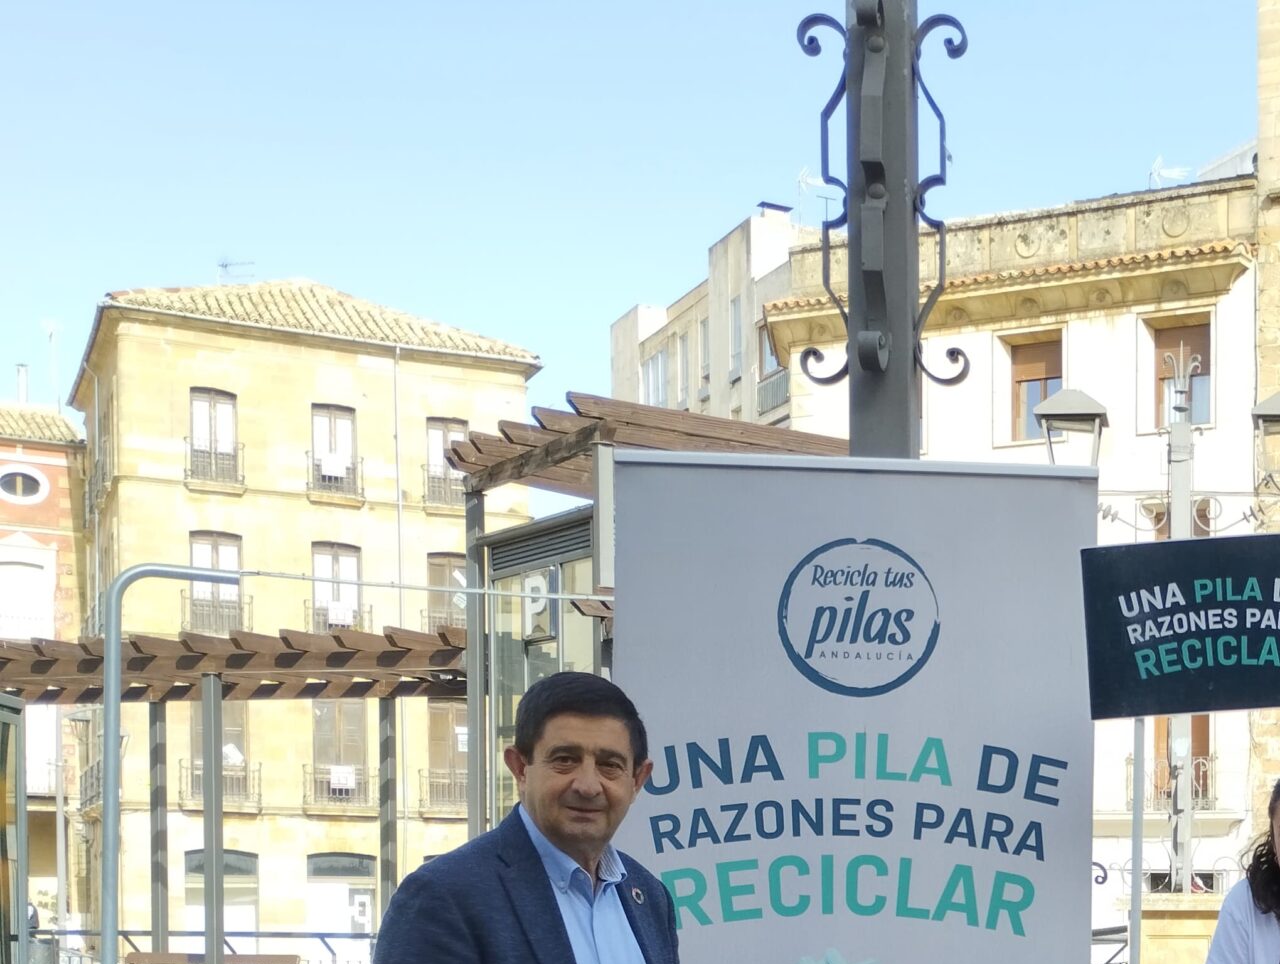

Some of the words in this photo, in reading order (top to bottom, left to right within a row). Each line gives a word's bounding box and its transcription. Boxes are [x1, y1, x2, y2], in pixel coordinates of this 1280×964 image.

[811, 563, 878, 588] Recicla
[884, 567, 915, 588] tus
[1118, 582, 1186, 618] UNA
[1194, 577, 1263, 603] PILA
[804, 590, 915, 659] pilas
[1126, 608, 1238, 644] RAZONES
[819, 650, 914, 661] ANDALUCÍA
[644, 735, 785, 796] UNA
[807, 731, 952, 787] PILA
[976, 745, 1069, 806] DE
[649, 797, 894, 854] RAZONES
[913, 802, 1046, 862] PARA
[661, 854, 1036, 937] RECICLAR
